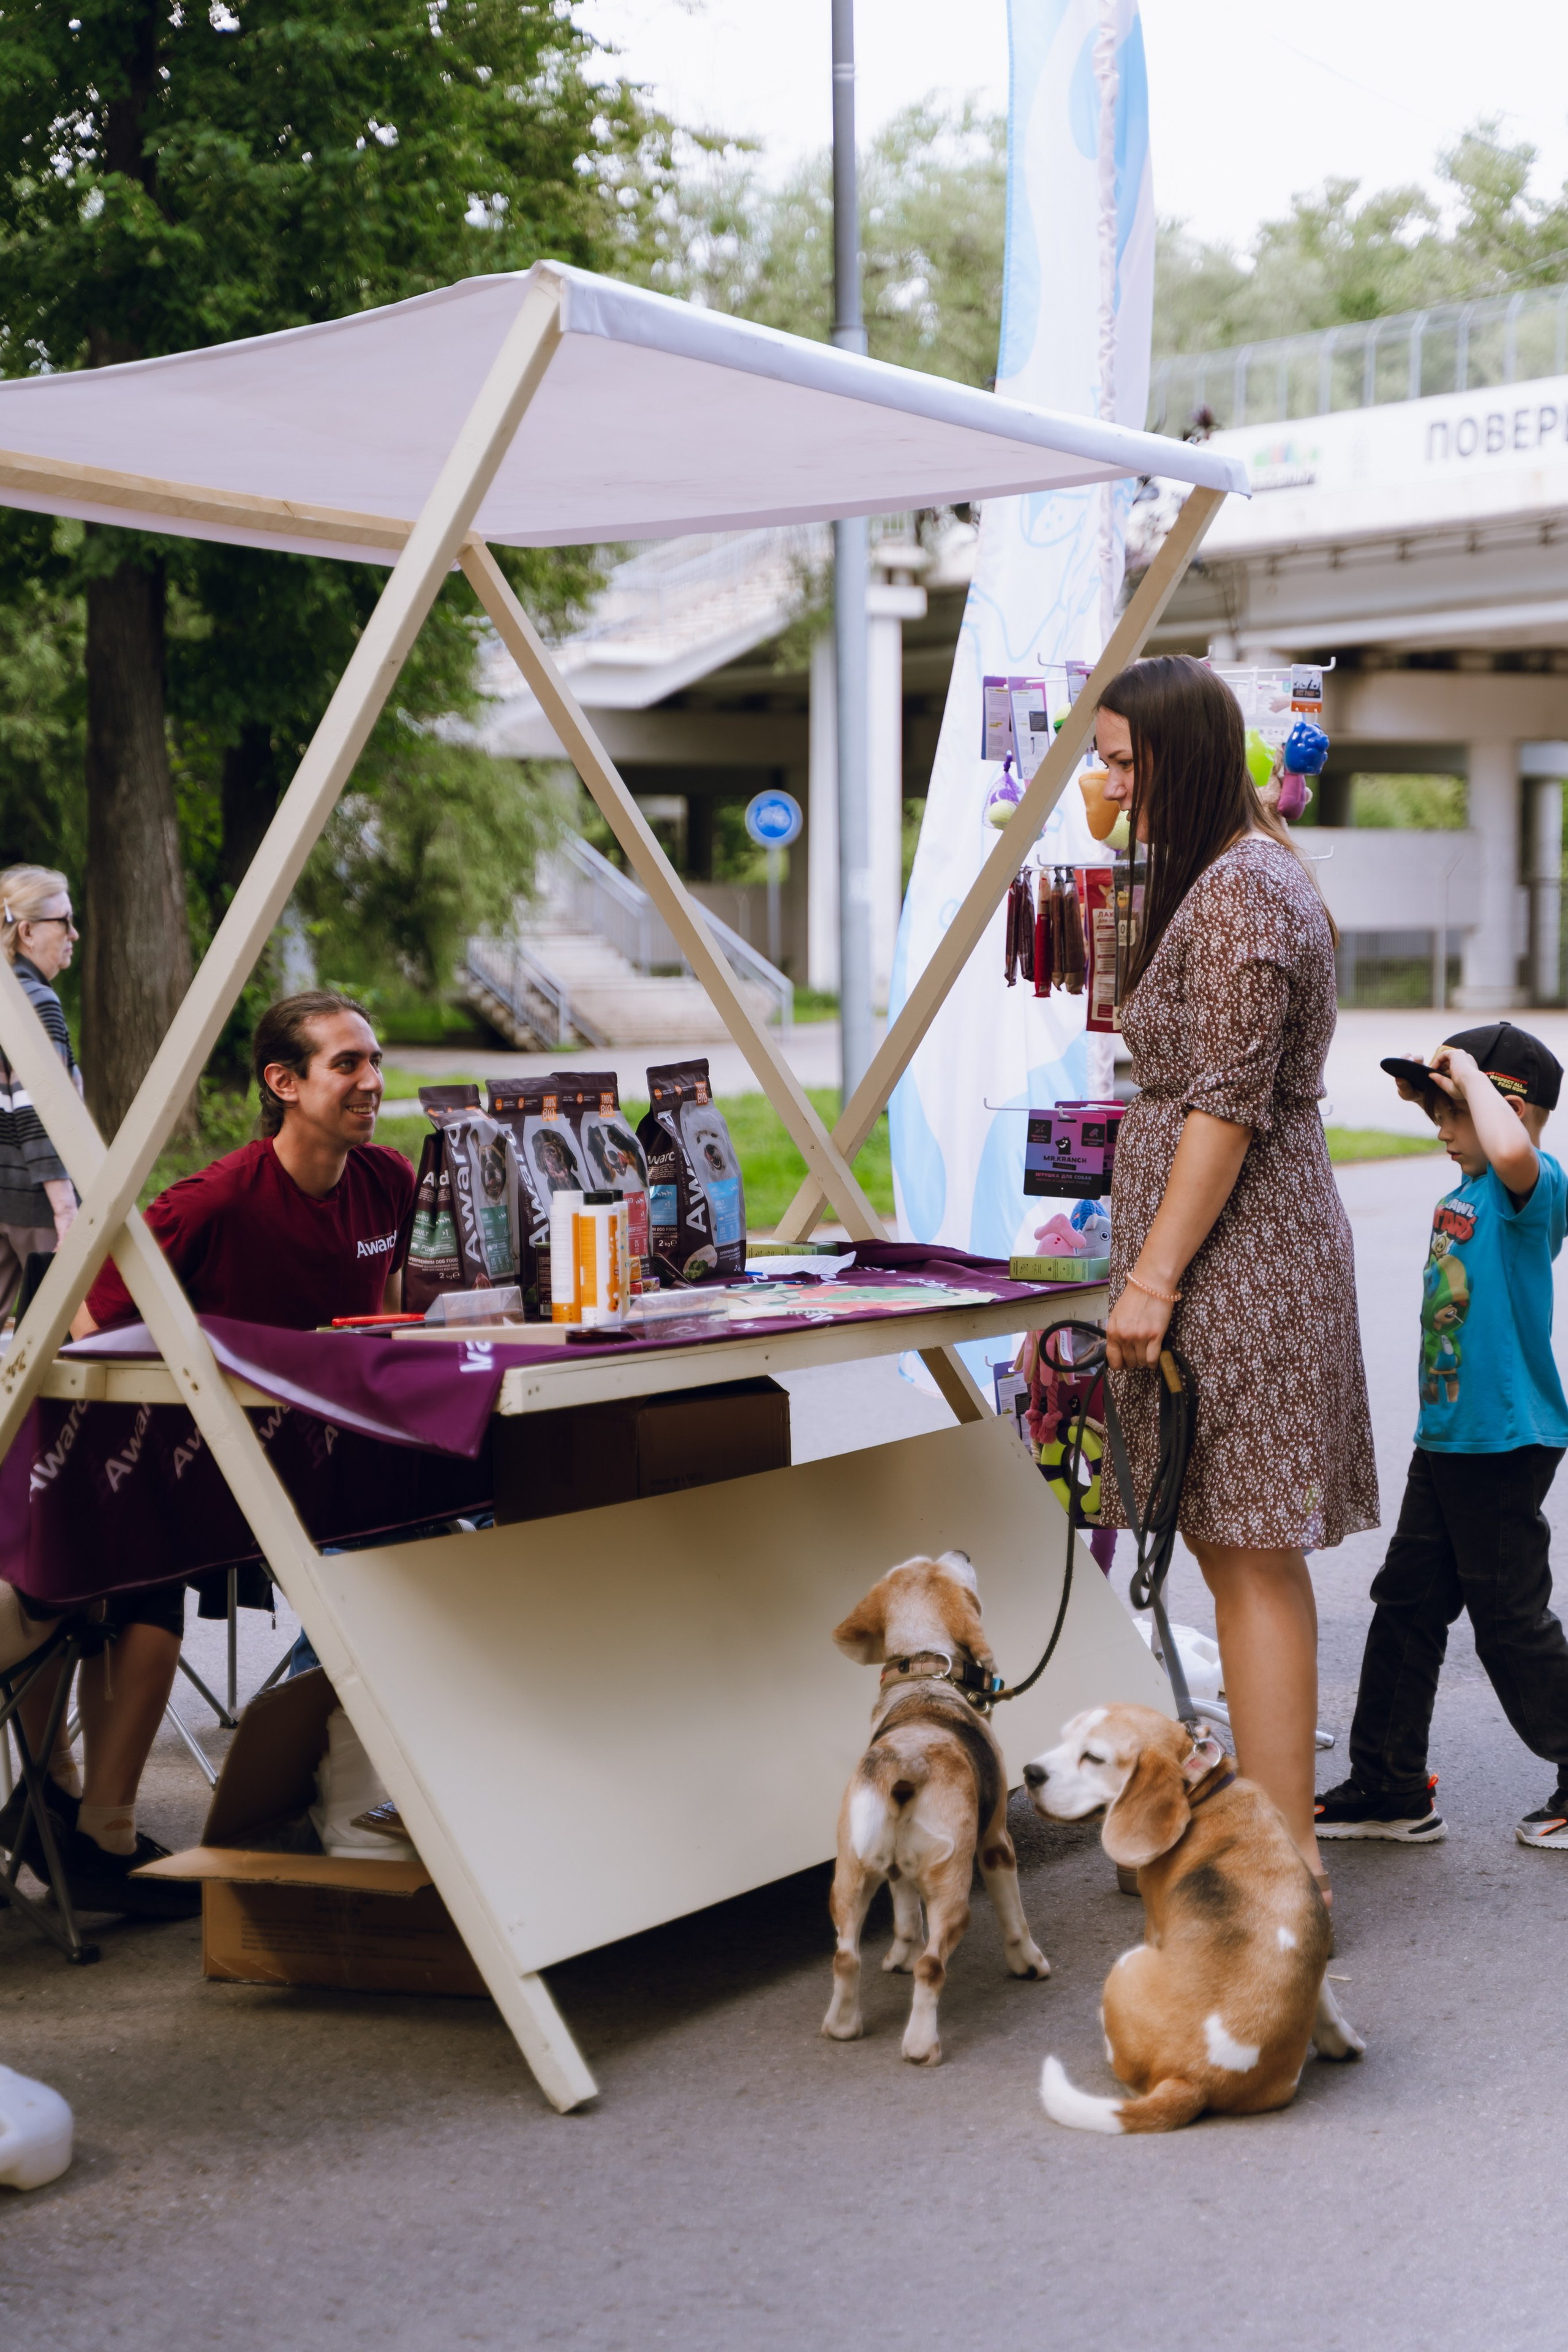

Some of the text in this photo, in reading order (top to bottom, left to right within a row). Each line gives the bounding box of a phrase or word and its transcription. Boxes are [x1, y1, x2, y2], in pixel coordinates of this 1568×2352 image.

[1425, 406, 1568, 461] ПОВЕР
[1490, 1075, 1514, 1085] RESPECT
[543, 1098, 556, 1107] 100%
[601, 1095, 612, 1104] 100%
[698, 1093, 707, 1104] BIO
[543, 1107, 555, 1119] BIO
[601, 1104, 612, 1115] BIO
[647, 1151, 676, 1164] war
[443, 1123, 481, 1263] Award
[1446, 1199, 1475, 1218] AWL
[415, 1213, 429, 1223] HYPO
[1434, 1205, 1477, 1240] TARS
[413, 1228, 429, 1237] ADULT
[357, 1229, 397, 1258] Award
